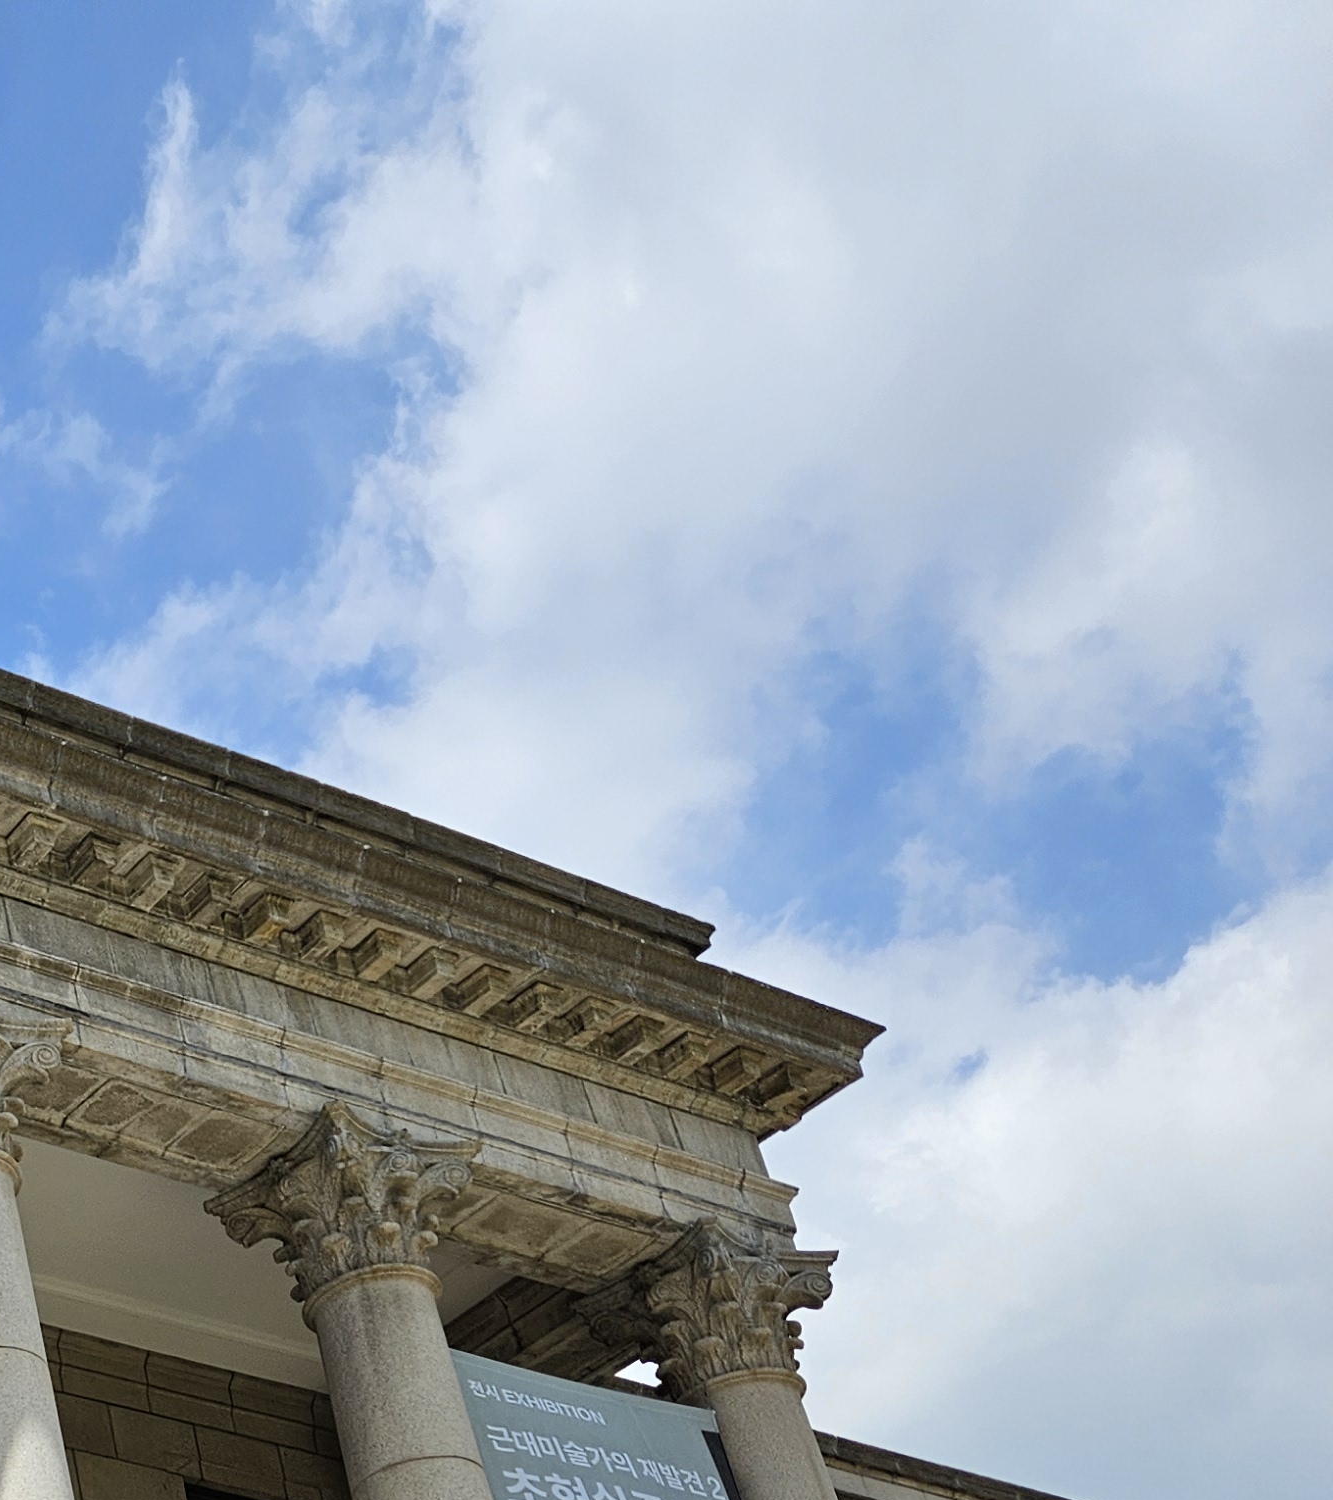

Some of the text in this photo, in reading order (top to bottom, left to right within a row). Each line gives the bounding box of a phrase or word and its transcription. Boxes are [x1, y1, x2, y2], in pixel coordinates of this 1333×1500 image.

[468, 1379, 606, 1426] 전시 EXHIBITION
[487, 1425, 725, 1500] 근대미술가의 재발견 2
